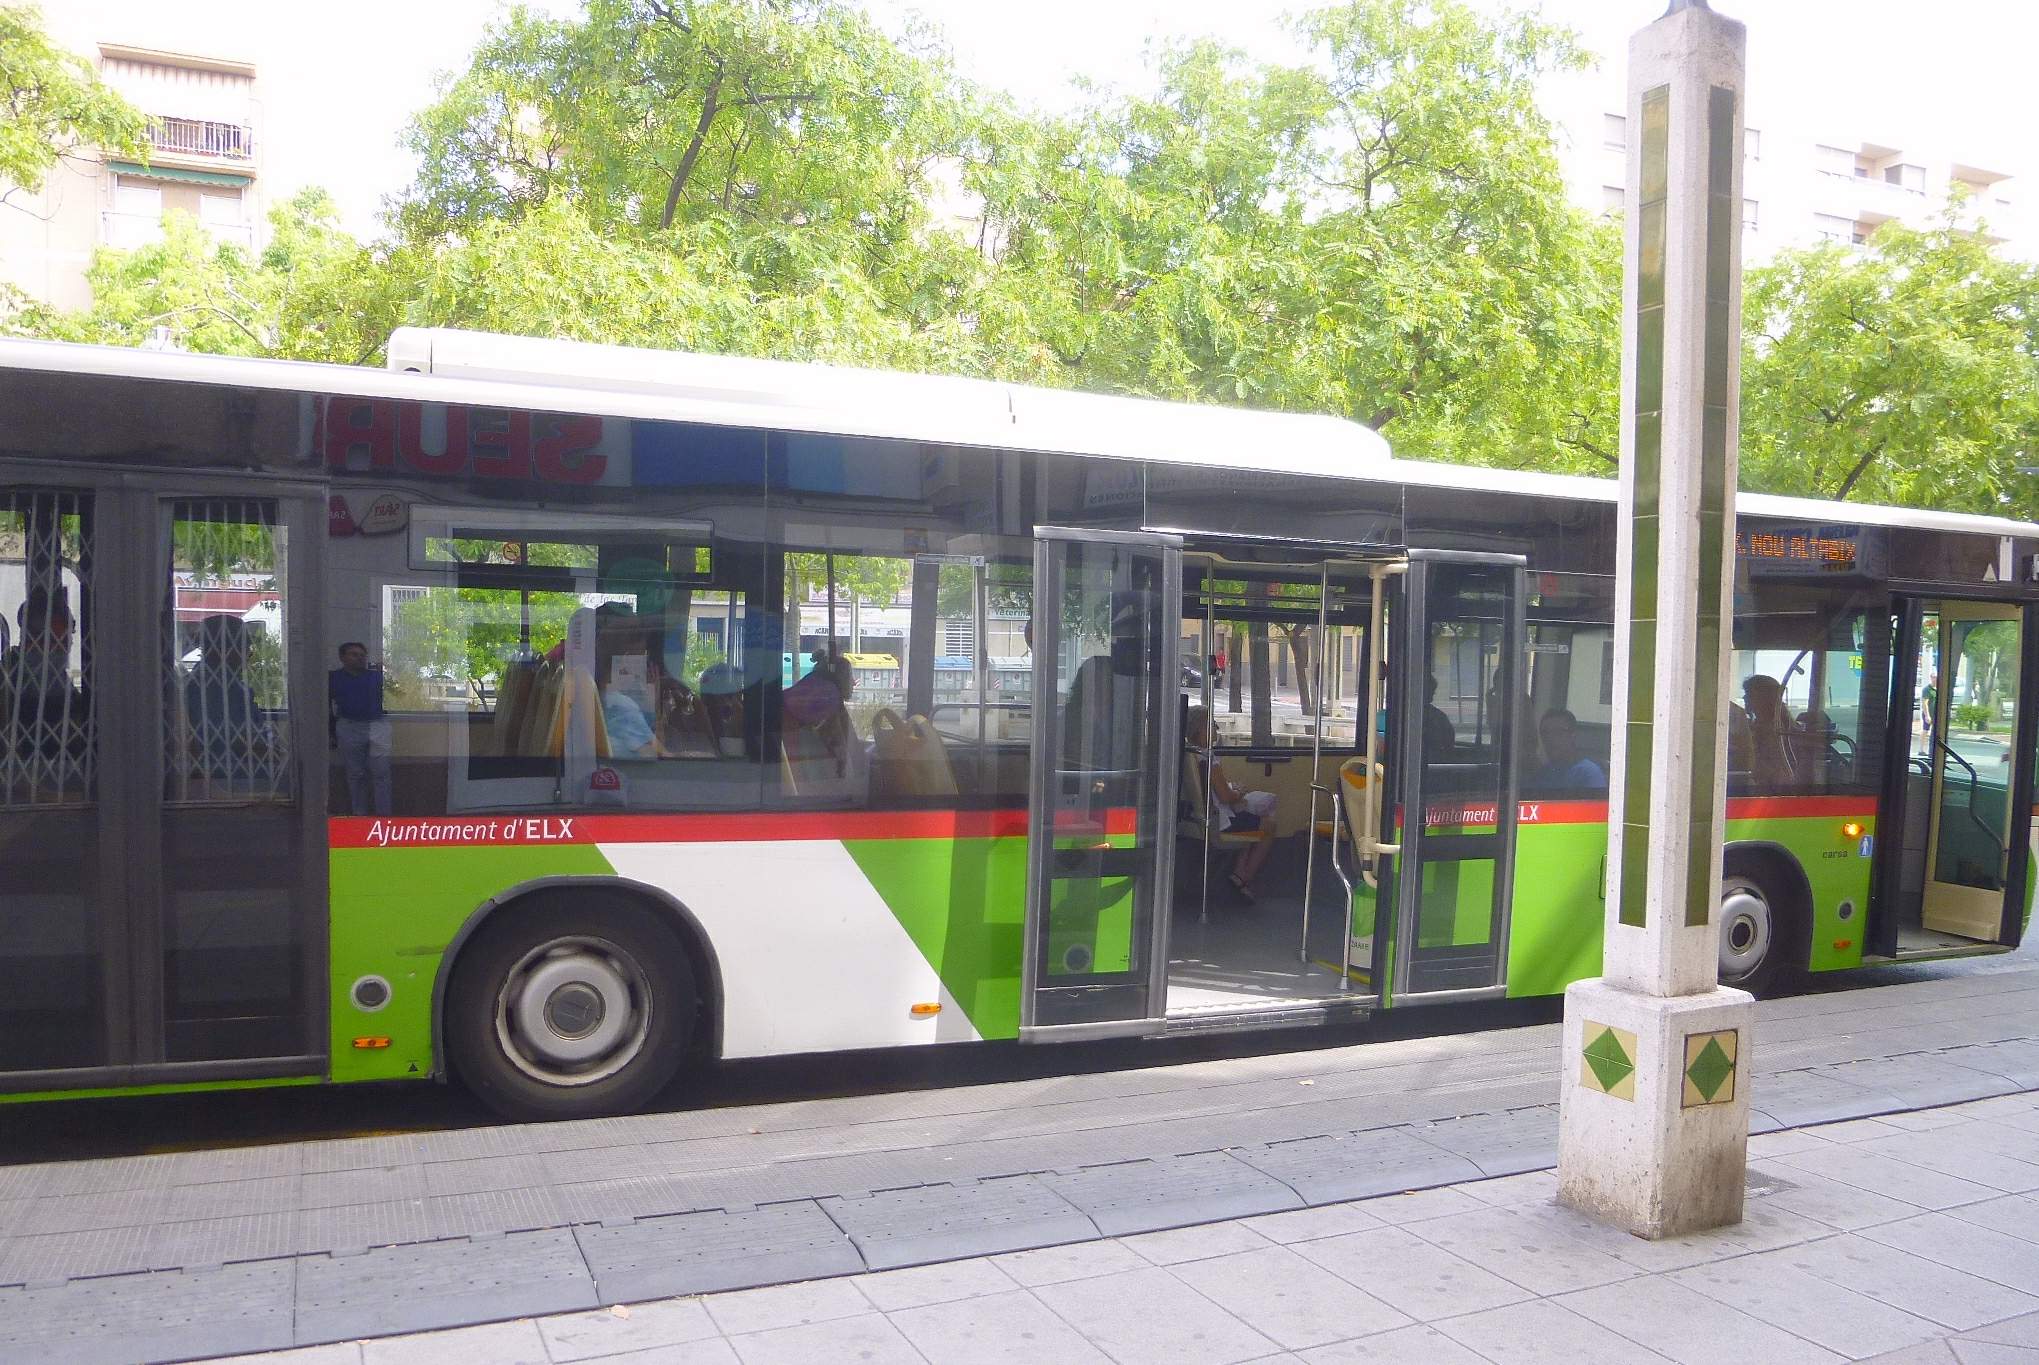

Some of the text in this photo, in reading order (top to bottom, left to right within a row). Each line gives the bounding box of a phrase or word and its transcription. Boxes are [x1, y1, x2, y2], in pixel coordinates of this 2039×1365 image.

[1752, 534, 1784, 558] NOU
[1517, 805, 1539, 821] LX
[367, 818, 573, 846] Ajuntament d'ELX
